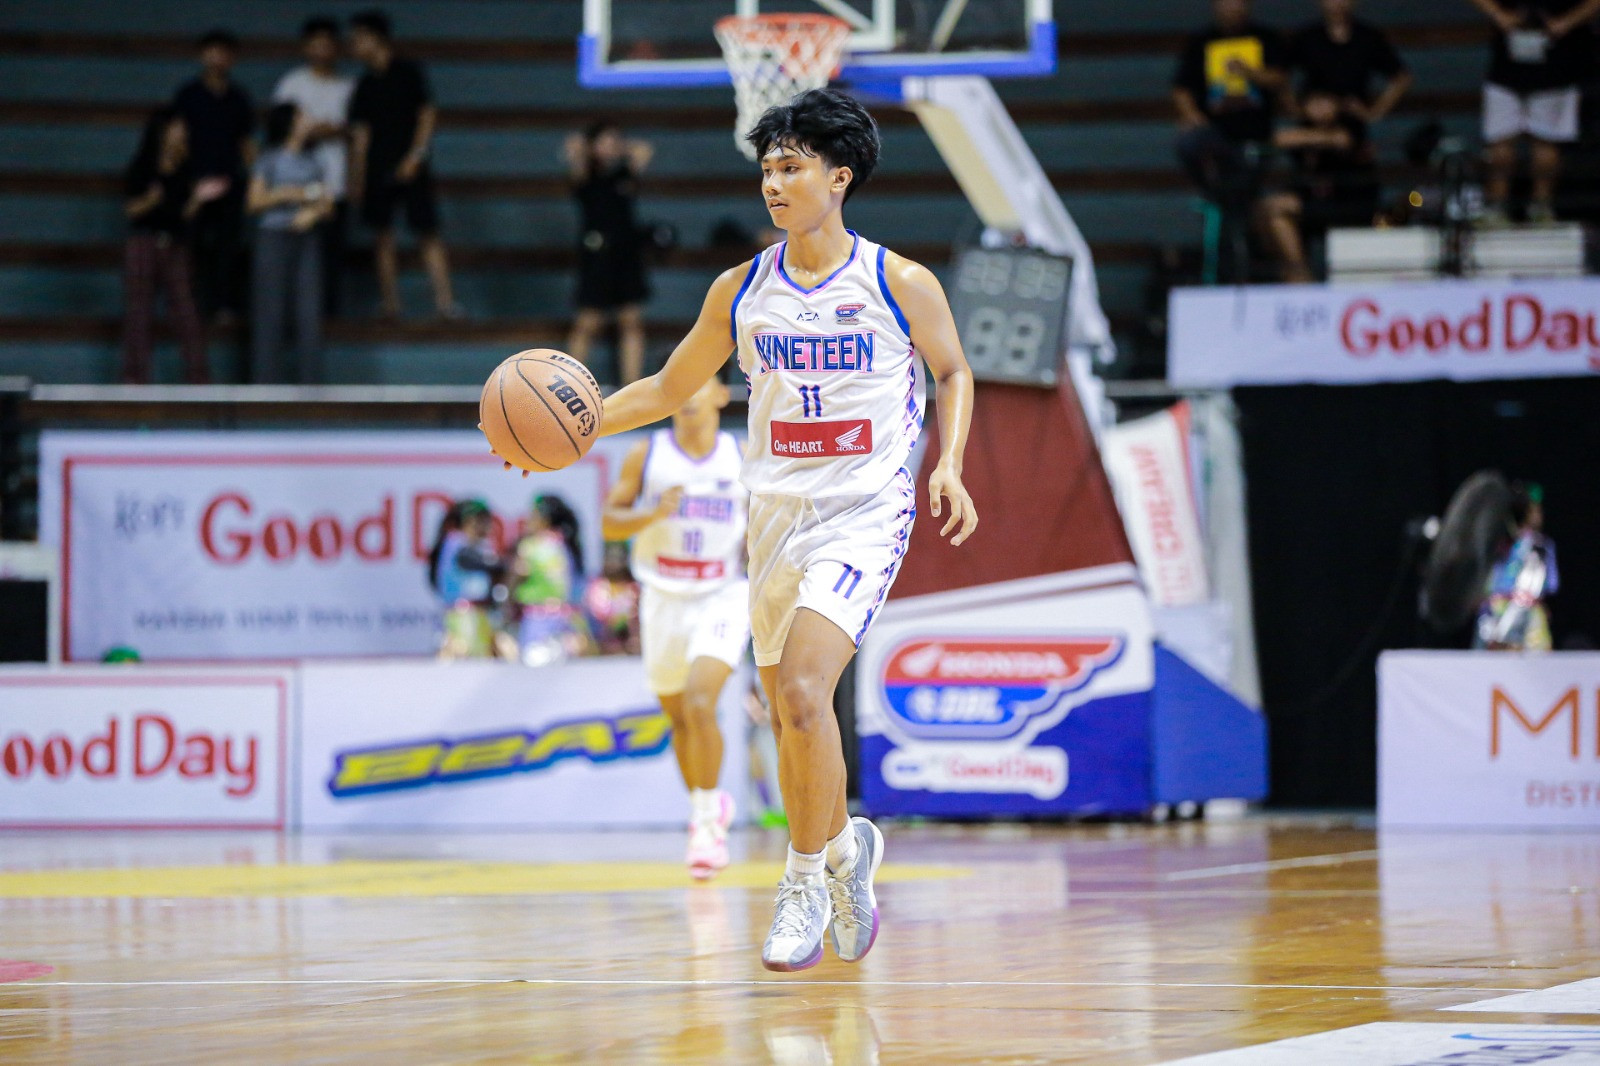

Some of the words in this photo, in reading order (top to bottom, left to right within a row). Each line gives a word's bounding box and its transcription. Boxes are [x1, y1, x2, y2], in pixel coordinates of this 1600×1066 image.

[1340, 297, 1493, 357] Good
[754, 332, 874, 374] NINETEEN
[547, 375, 588, 416] DBL
[799, 384, 822, 418] 11
[774, 439, 788, 452] One
[789, 440, 825, 454] HEART.
[201, 491, 394, 565] Good
[832, 563, 863, 600] 11
[1490, 686, 1600, 759] M
[0, 716, 118, 780] ood
[133, 713, 258, 798] Day
[1525, 781, 1600, 807] DIST
